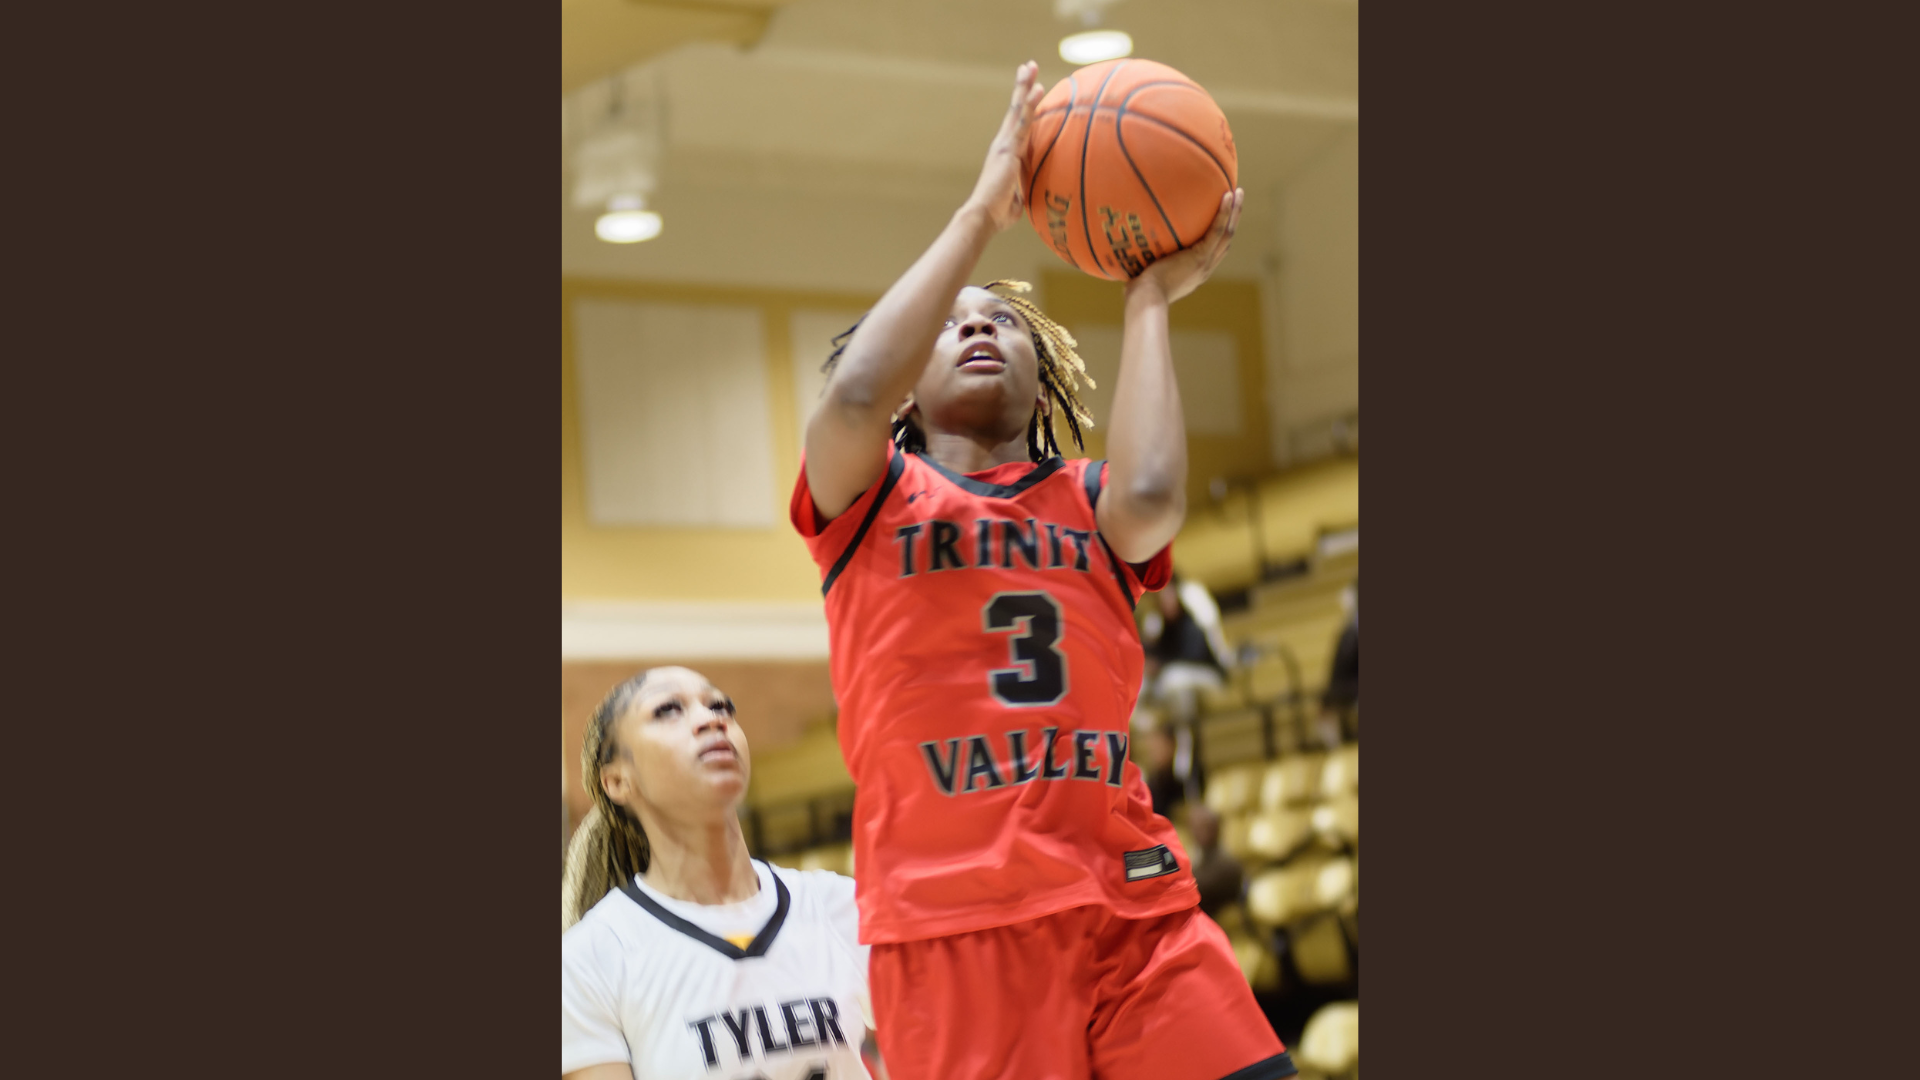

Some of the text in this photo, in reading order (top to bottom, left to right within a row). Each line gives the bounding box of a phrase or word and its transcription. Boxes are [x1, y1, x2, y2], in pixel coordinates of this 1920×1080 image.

[981, 590, 1069, 708] 3
[918, 726, 1128, 797] VALLEY
[685, 995, 850, 1072] TYLER
